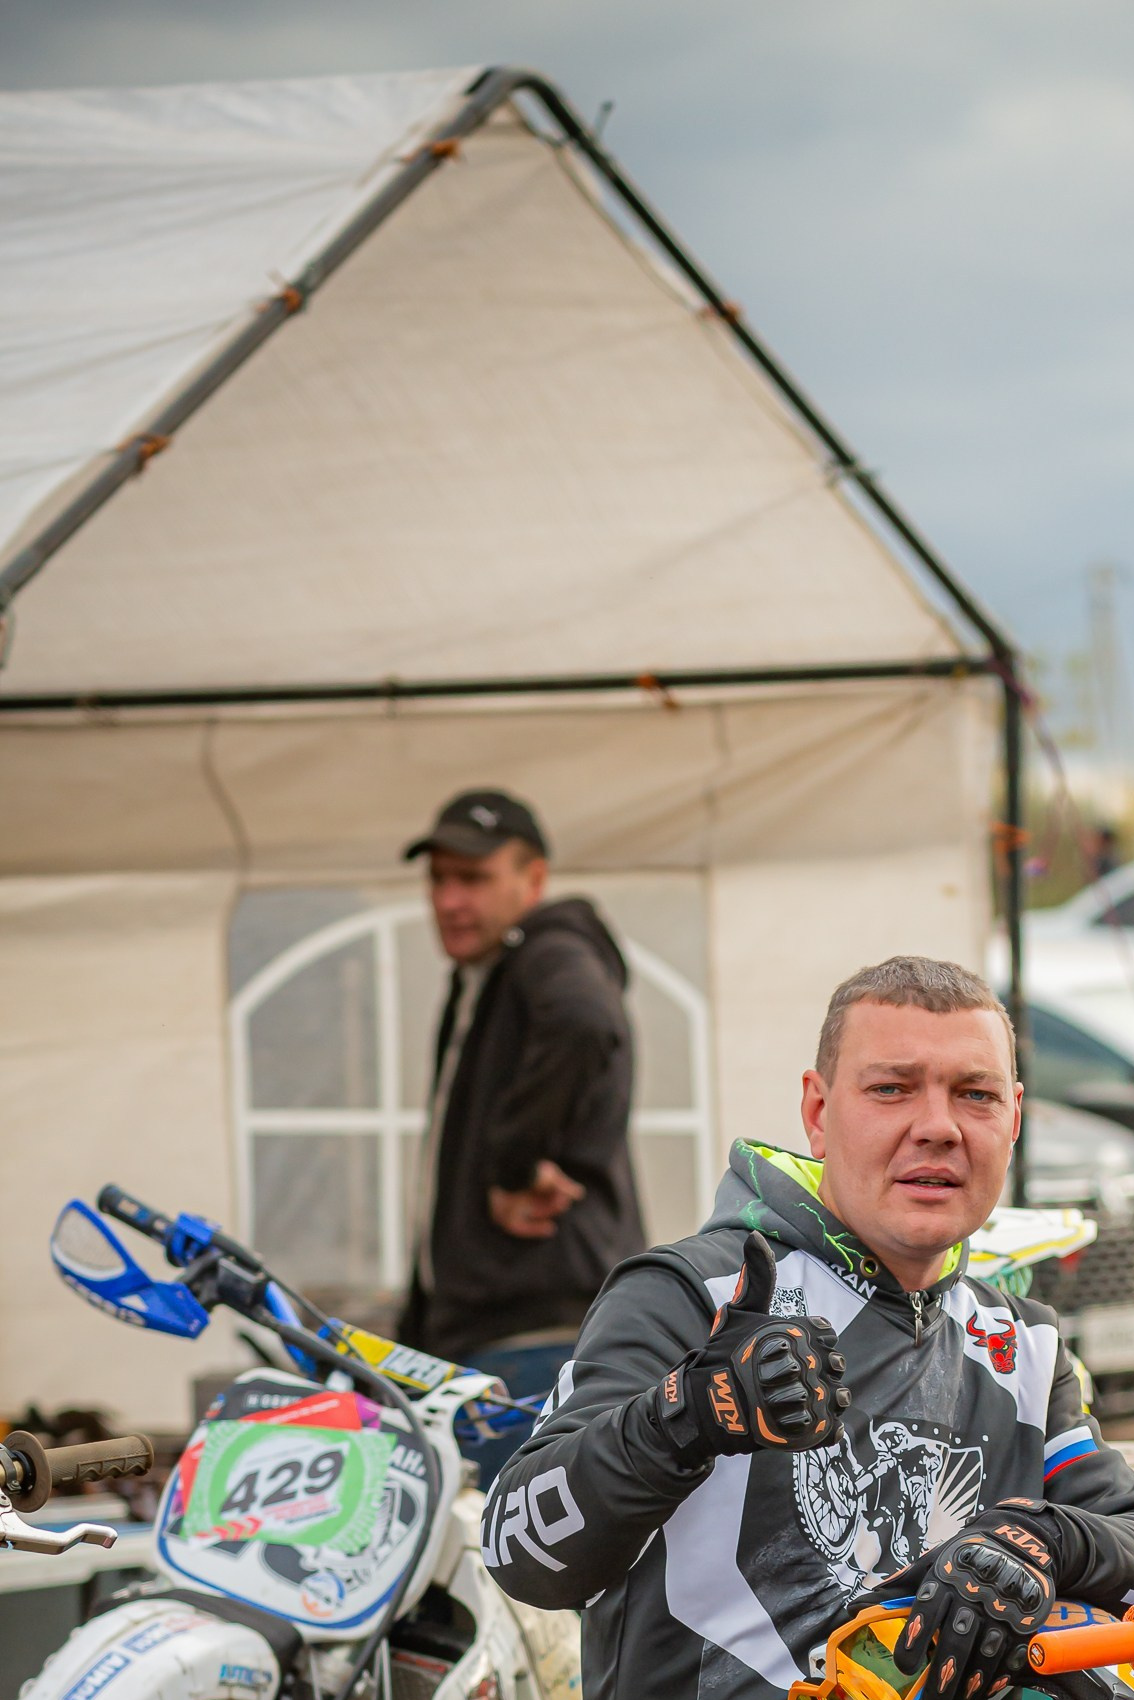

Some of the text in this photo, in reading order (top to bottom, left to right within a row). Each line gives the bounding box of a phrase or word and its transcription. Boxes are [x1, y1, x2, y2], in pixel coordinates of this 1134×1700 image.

[664, 1371, 679, 1403] KTM
[708, 1371, 745, 1433] KTM
[219, 1450, 345, 1517] 429
[994, 1524, 1051, 1566] KTM
